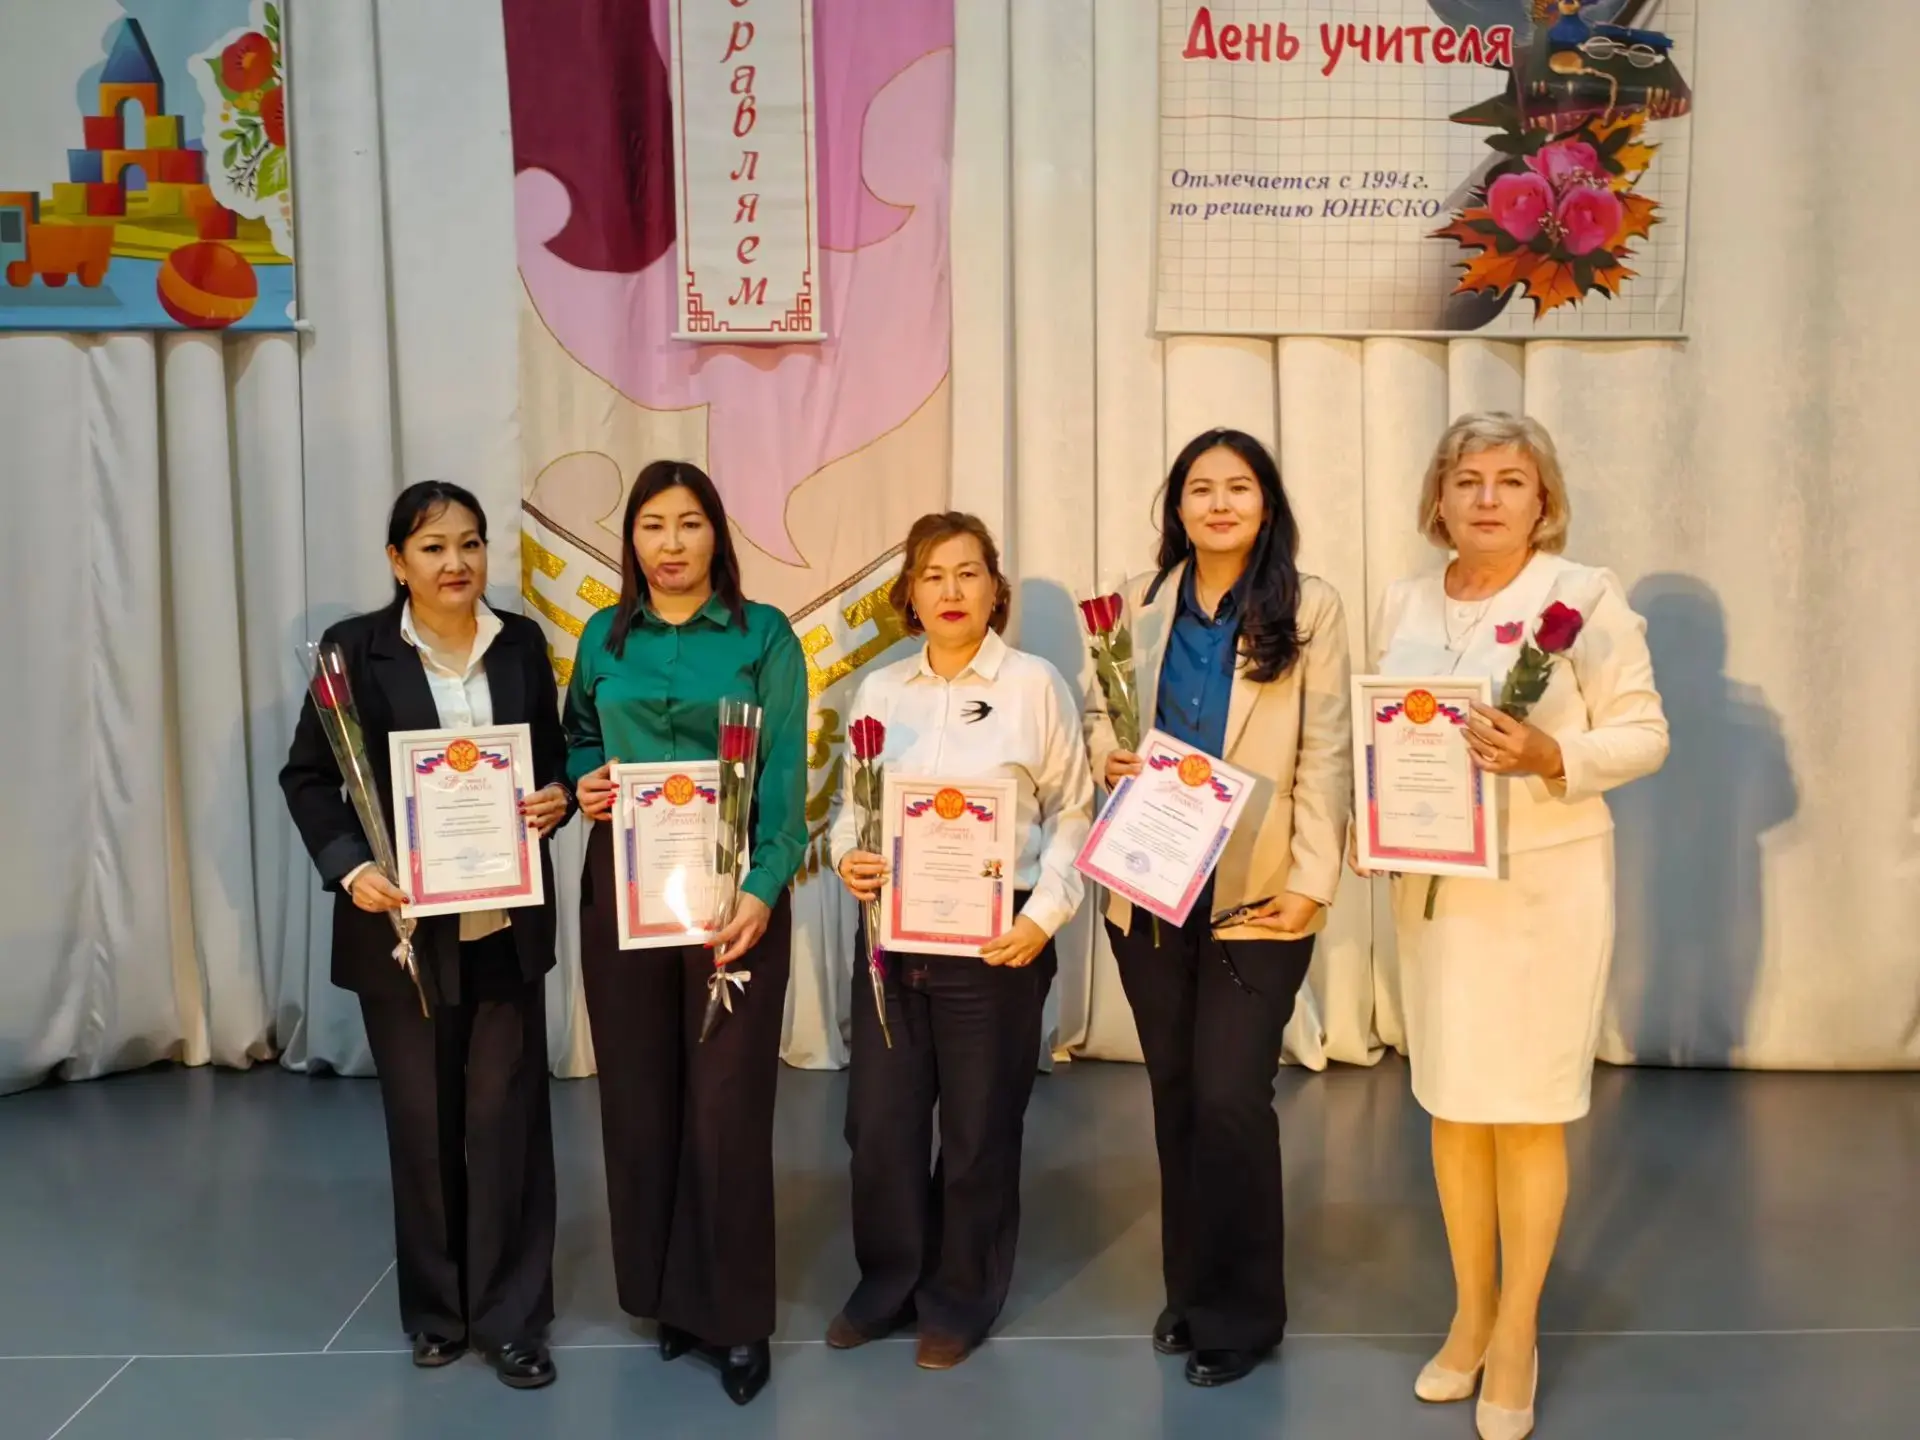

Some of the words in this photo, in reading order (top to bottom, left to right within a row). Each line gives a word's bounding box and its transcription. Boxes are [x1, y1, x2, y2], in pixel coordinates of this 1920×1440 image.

[1182, 6, 1300, 62] День
[1319, 23, 1512, 76] учителя
[719, 0, 768, 305] равляем
[1171, 168, 1330, 189] Отмечается
[1339, 175, 1351, 189] с
[1169, 202, 1198, 216] по
[1203, 201, 1313, 220] решению
[1322, 198, 1440, 218] ЮНЕСКО
